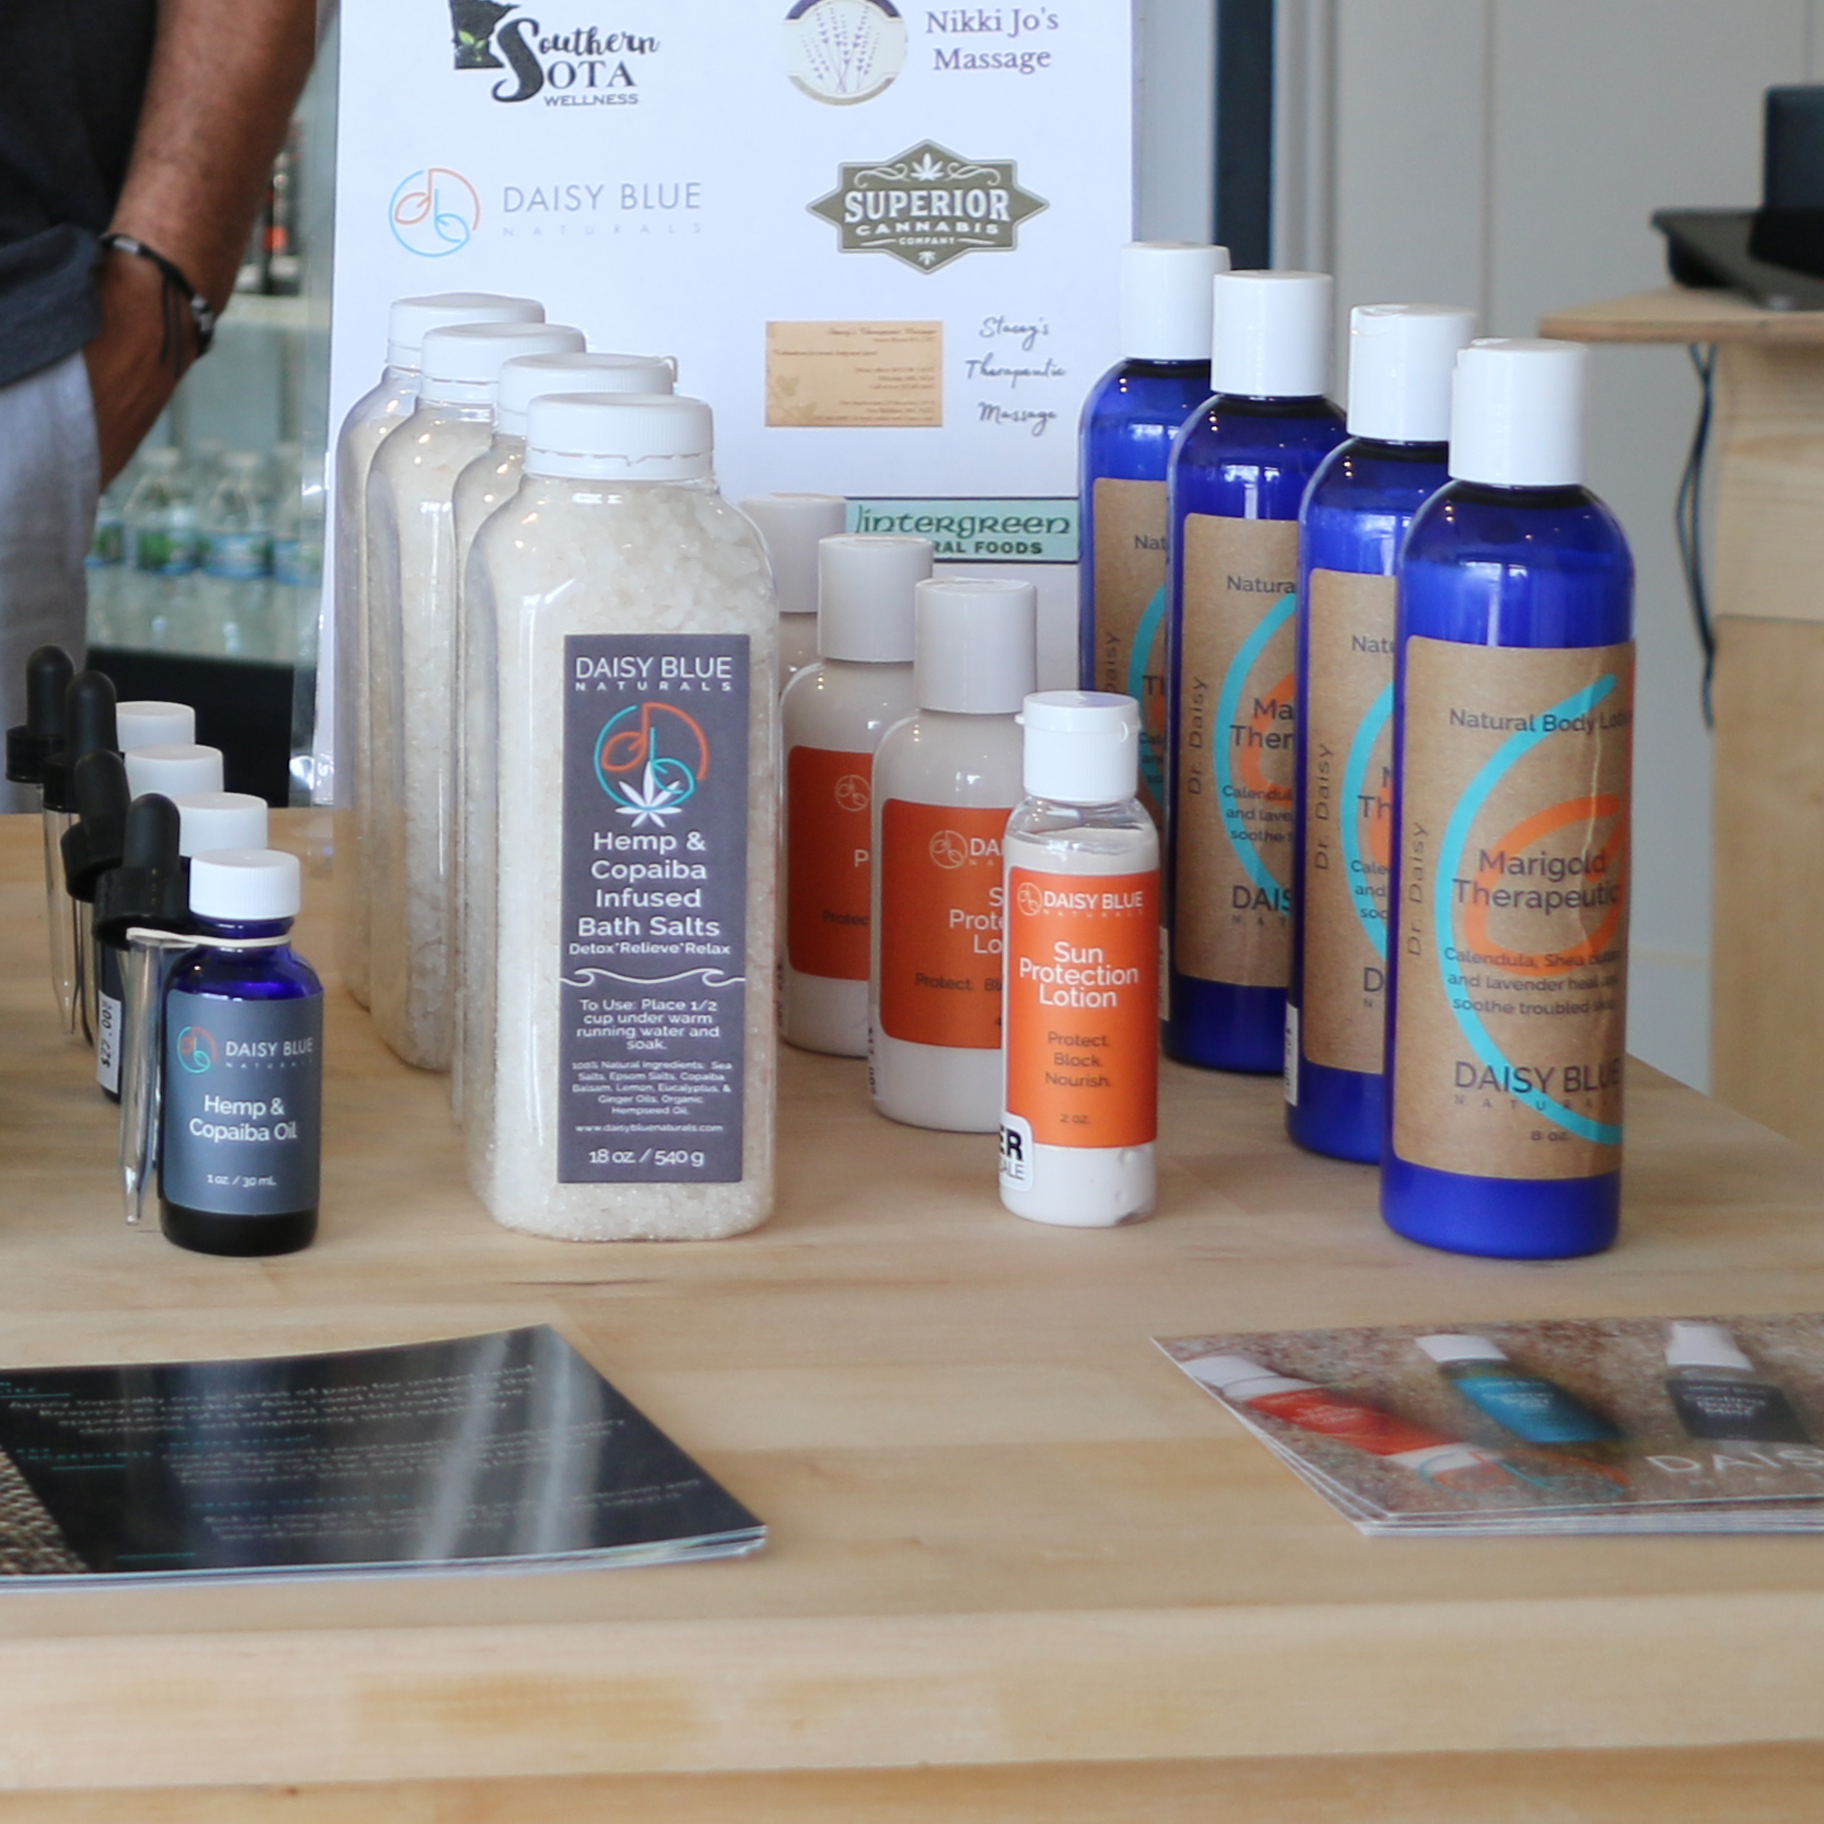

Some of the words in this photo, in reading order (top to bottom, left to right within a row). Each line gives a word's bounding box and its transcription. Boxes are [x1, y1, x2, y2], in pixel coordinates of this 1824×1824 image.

[925, 8, 1003, 34] Nikki
[1007, 7, 1060, 38] Jo's
[491, 17, 660, 103] Southern
[933, 47, 1052, 75] Massage
[543, 93, 639, 107] WELLNESS
[503, 184, 604, 213] DAISY
[621, 182, 701, 210] BLUE
[843, 188, 1011, 223] SUPERIOR
[503, 224, 701, 237] NATURALS
[855, 221, 1000, 236] CANNABIS
[898, 236, 955, 246] COMPANY
[979, 316, 1050, 352] Stacey's
[978, 401, 1057, 437] Massage
[854, 504, 1070, 539] intergreen
[974, 540, 1043, 554] FOODS
[576, 656, 653, 679] DAISY
[661, 656, 732, 678] BLUE
[575, 680, 732, 692] NATURALS
[1188, 677, 1209, 749] Daisy
[1450, 708, 1536, 732] Natural
[1542, 713, 1596, 735] Body
[1188, 763, 1202, 795] Dr.
[593, 832, 677, 854] Hemp
[686, 832, 706, 851] &
[591, 859, 707, 883] Copaiba
[1408, 822, 1430, 904] Daisy
[1479, 848, 1606, 883] Marigold
[596, 888, 702, 908] Infused
[1043, 891, 1100, 909] DAISY
[1103, 891, 1144, 908] BLUE
[1453, 879, 1620, 915] Therapeutic
[578, 917, 640, 937] Bath
[649, 917, 720, 937] Salts
[1408, 919, 1422, 956] Dr.
[1054, 941, 1103, 964] Sun
[1020, 957, 1139, 985] Protection
[1447, 973, 1480, 988] and
[1486, 976, 1564, 991] lavender
[579, 999, 598, 1011] To
[602, 999, 636, 1011] Use:
[641, 999, 685, 1011] Place
[691, 1000, 718, 1012] 1/2
[1039, 983, 1118, 1008] Lotion
[1452, 998, 1515, 1014] soothe
[1519, 1001, 1589, 1015] troubled
[583, 1014, 612, 1026] cup
[618, 1013, 663, 1024] under
[668, 1014, 713, 1024] warm
[576, 1026, 635, 1039] running
[640, 1027, 686, 1038] water
[689, 1026, 720, 1038] and
[225, 1040, 278, 1058] DAISY
[283, 1037, 314, 1056] BLUE
[1455, 1061, 1555, 1094] DAISY
[204, 1094, 267, 1120] Hemp
[270, 1097, 285, 1116] &
[189, 1117, 270, 1143] Copaiba
[273, 1121, 298, 1140] Oil
[588, 1149, 608, 1163] 18
[612, 1151, 636, 1163] oz
[654, 1149, 688, 1165] 540
[691, 1151, 705, 1167] g
[1645, 1449, 1824, 1472] DAIS
